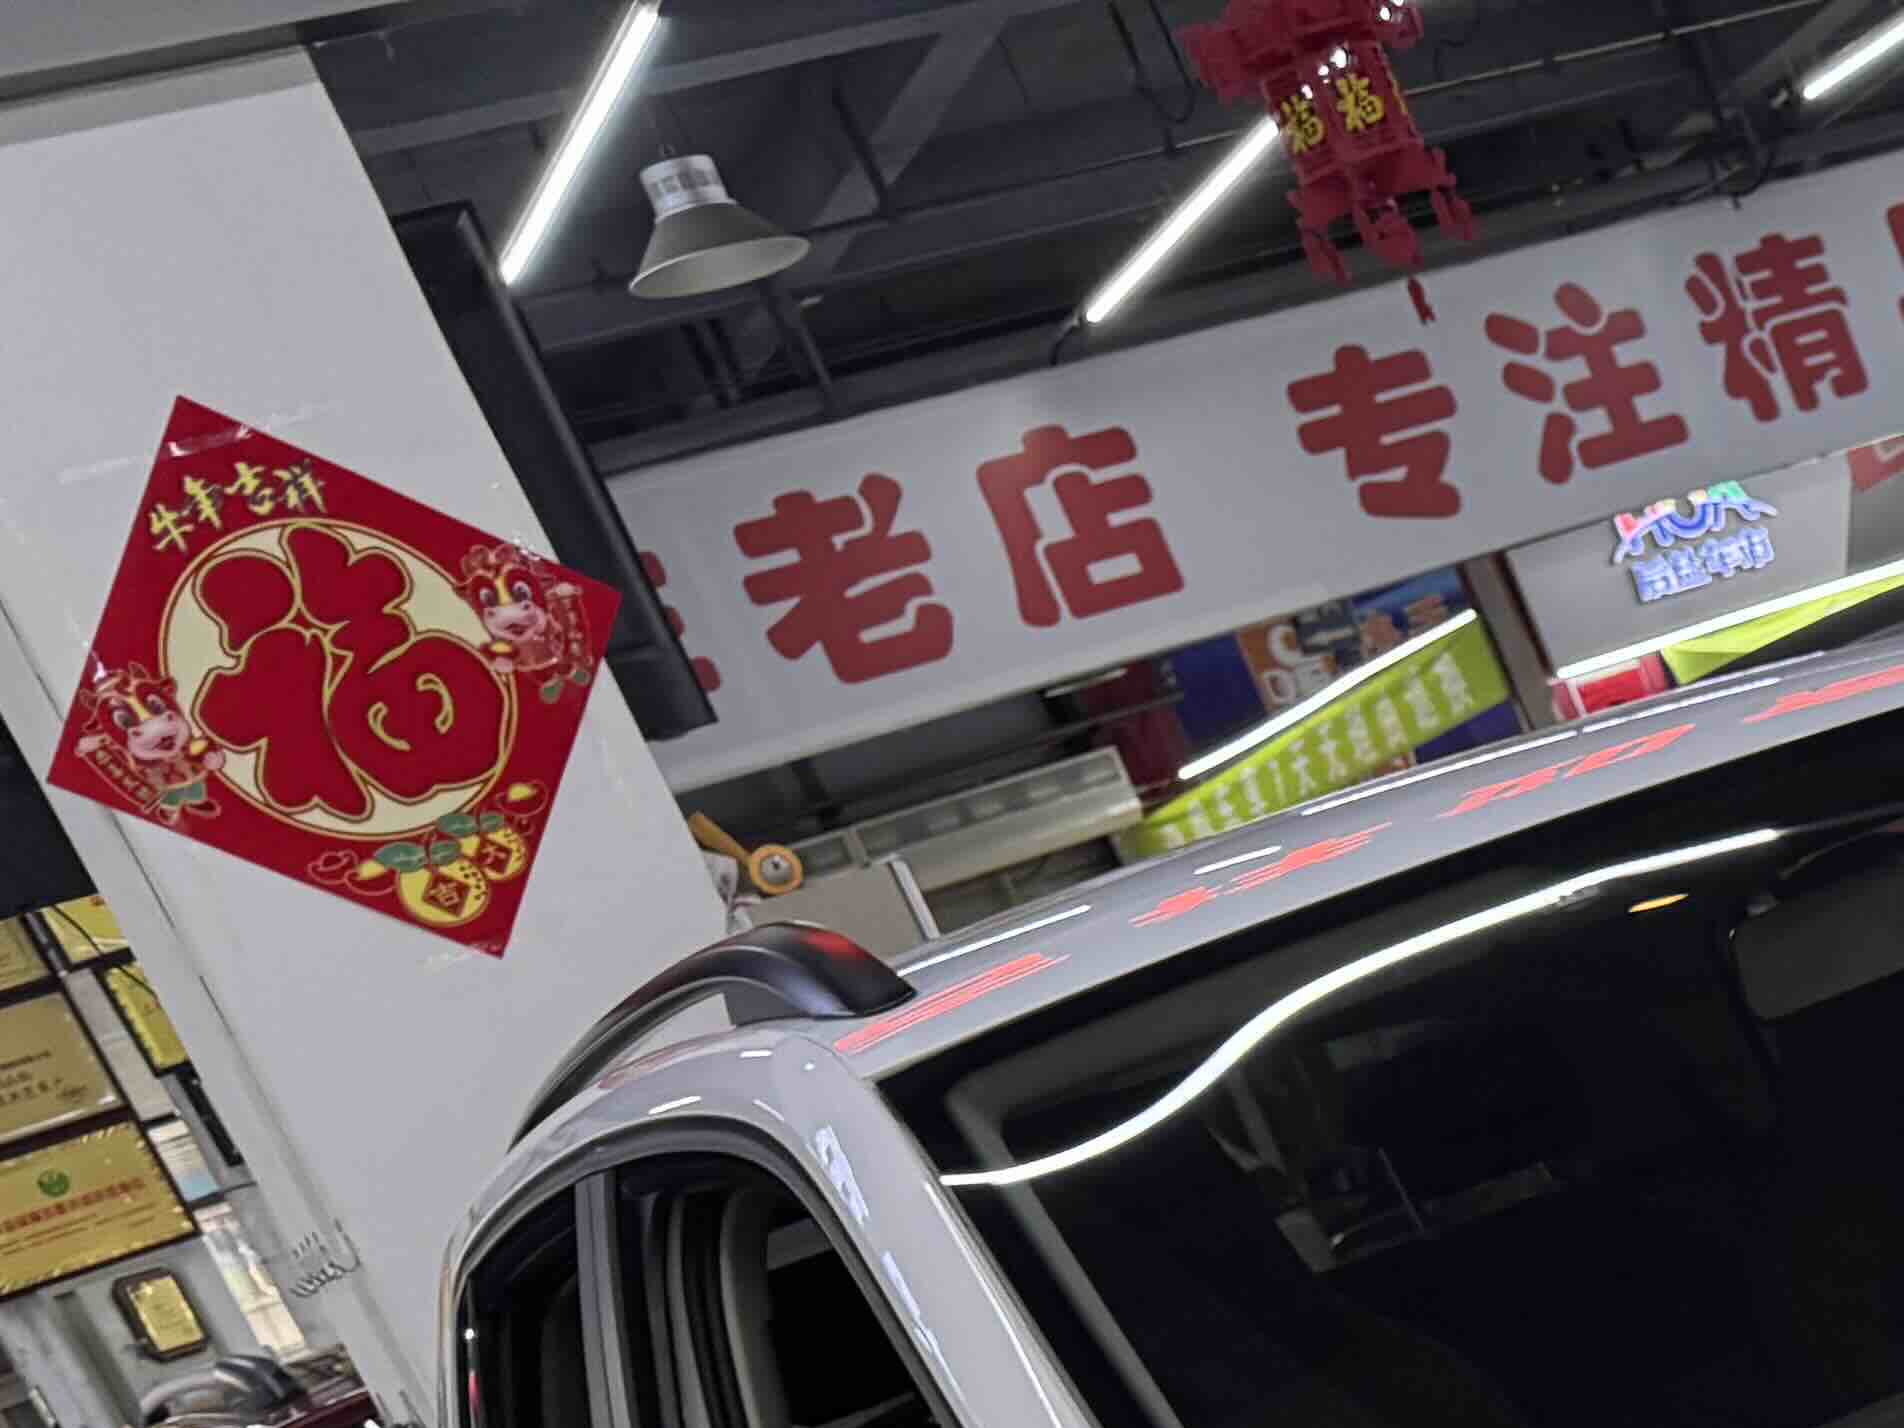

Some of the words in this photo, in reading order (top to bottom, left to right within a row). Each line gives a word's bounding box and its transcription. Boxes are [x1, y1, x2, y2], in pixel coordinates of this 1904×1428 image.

[1335, 72, 1385, 132] 福
[192, 524, 507, 822] 福
[638, 423, 1185, 692] 老店
